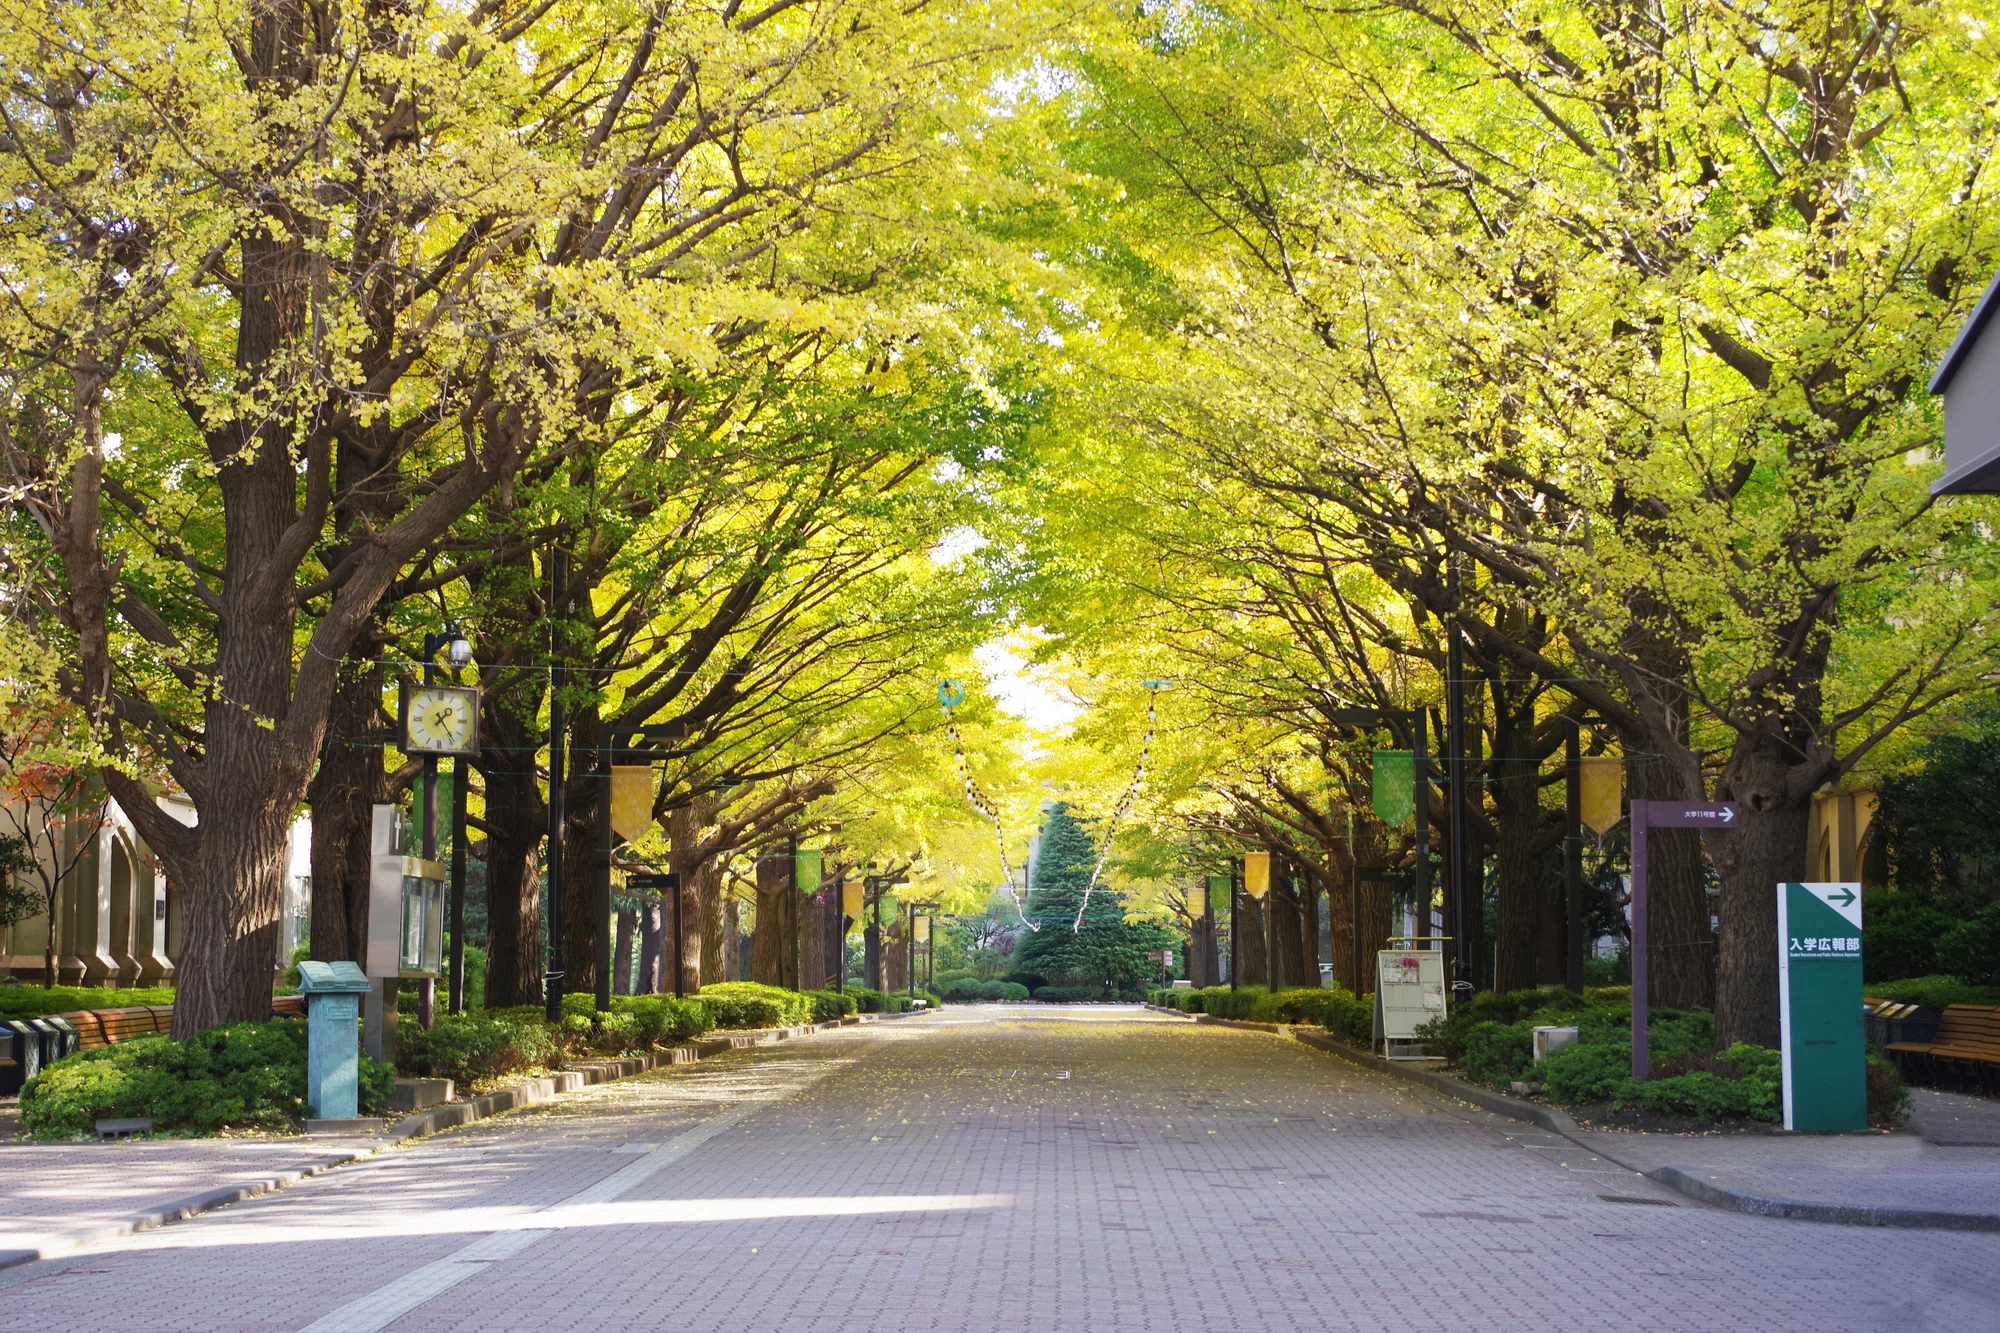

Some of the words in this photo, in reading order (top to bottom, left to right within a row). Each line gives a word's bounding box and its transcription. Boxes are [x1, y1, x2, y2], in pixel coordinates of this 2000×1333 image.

[1789, 937, 1860, 951] 入学広報部
